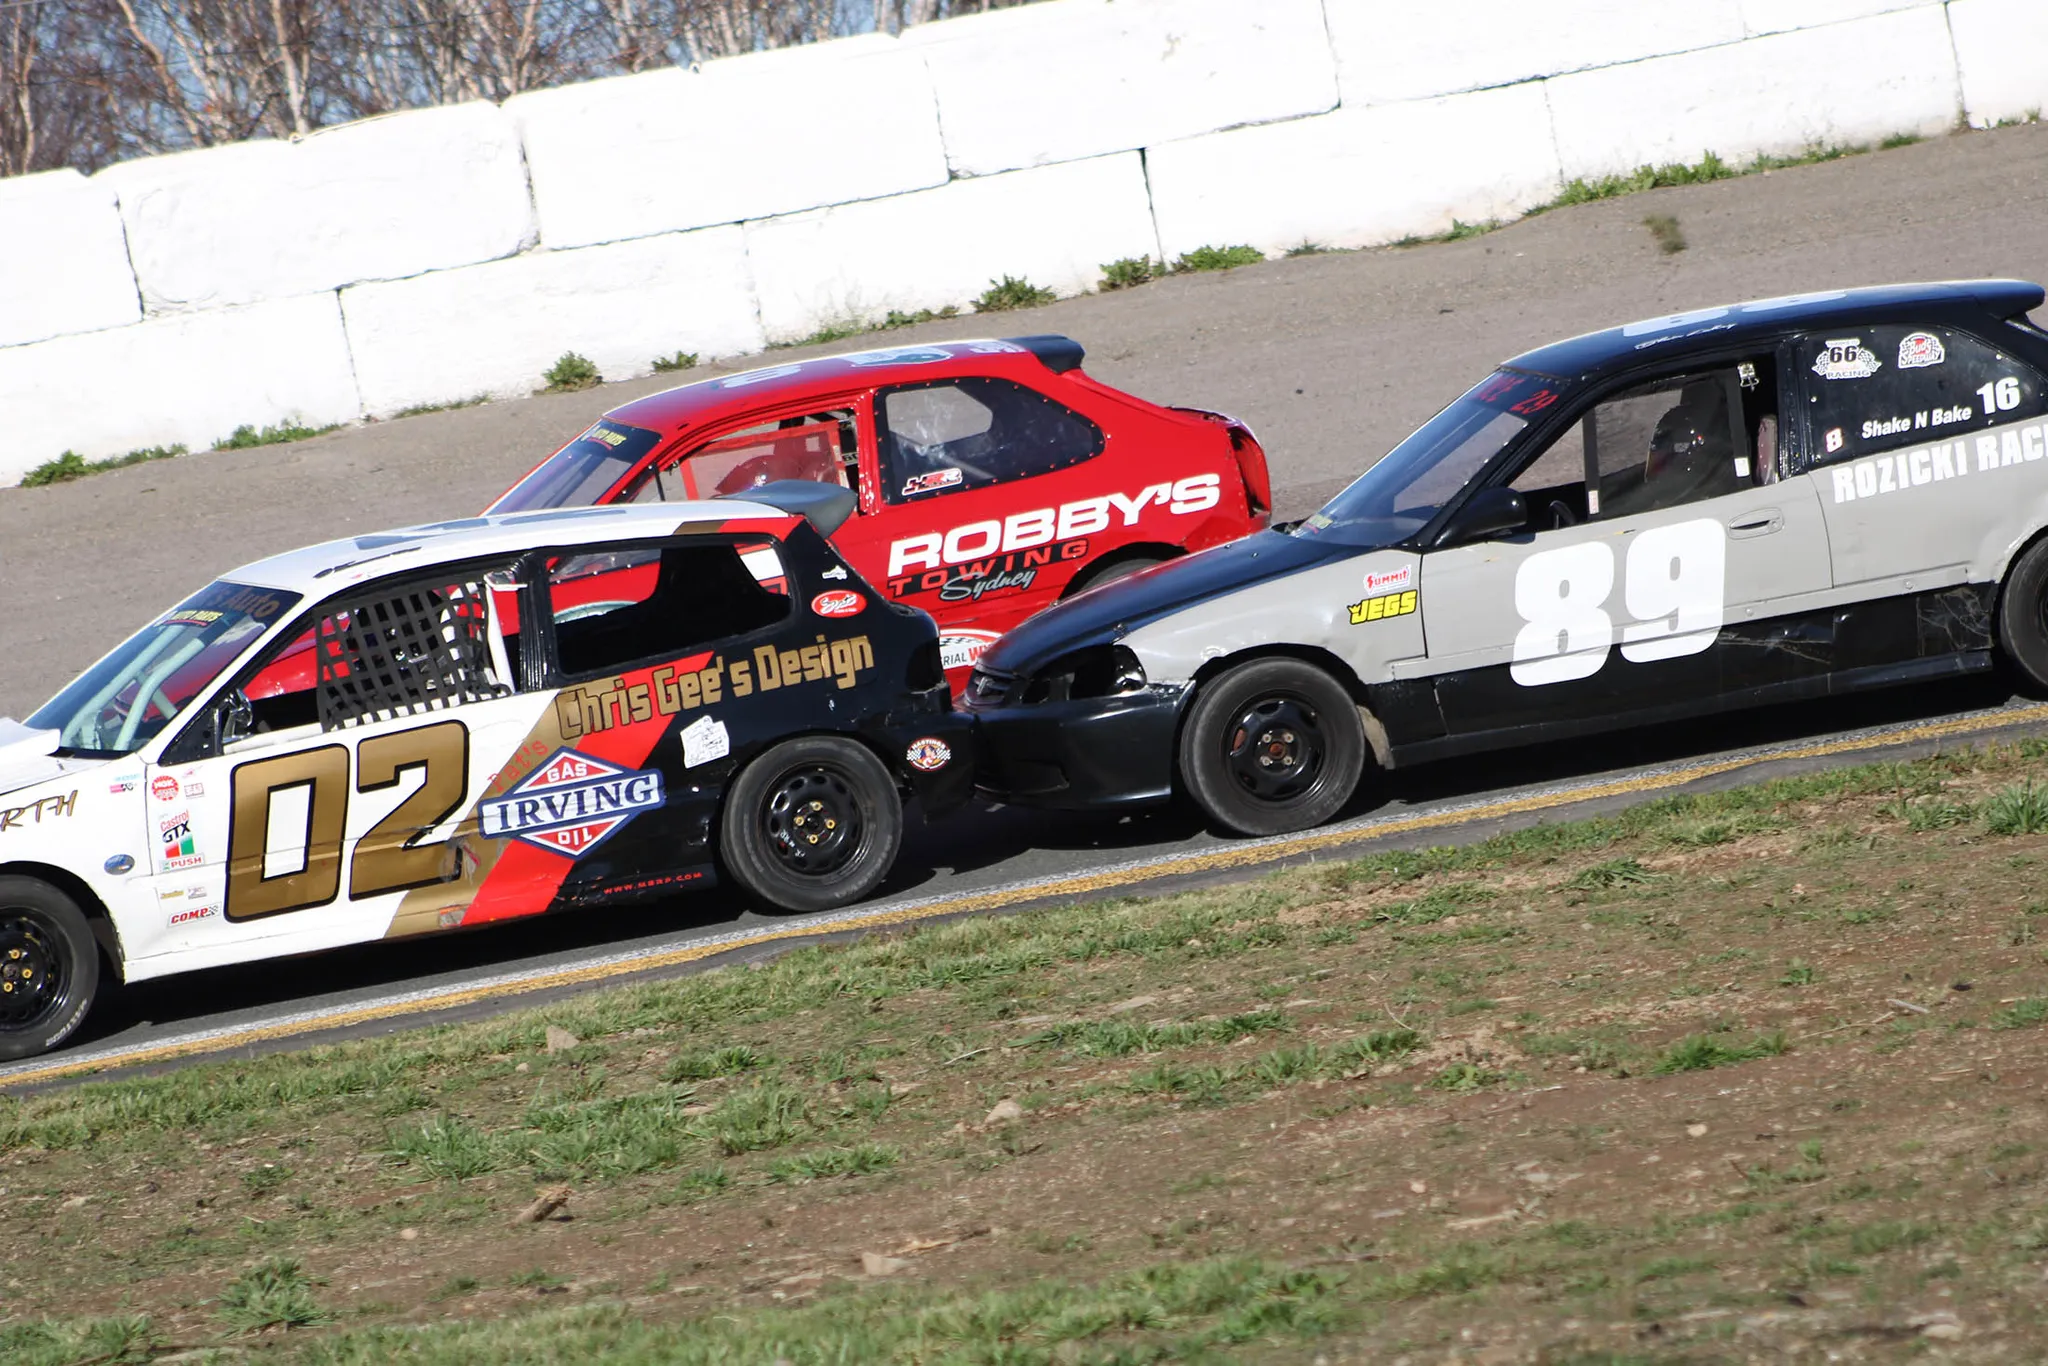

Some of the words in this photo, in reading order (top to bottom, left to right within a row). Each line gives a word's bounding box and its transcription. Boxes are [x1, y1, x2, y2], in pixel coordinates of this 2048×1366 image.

[1829, 345, 1857, 363] 66
[1827, 369, 1870, 379] RACING
[1976, 376, 2021, 415] 16
[1825, 427, 1844, 452] 8
[1861, 416, 1911, 439] Shake
[1915, 411, 1929, 428] N
[1931, 404, 1972, 427] Bake
[1831, 440, 1969, 504] ROZICKI
[886, 473, 1221, 577] ROBBY'S
[887, 539, 1088, 597] TOWING
[940, 568, 1037, 601] Sydney
[1348, 589, 1418, 625] JEGS
[1510, 518, 1726, 687] 89
[556, 678, 652, 740] Chris
[653, 655, 752, 716] Gee's
[753, 634, 875, 690] Design
[546, 761, 588, 783] GAS
[160, 809, 190, 832] Castrol
[496, 776, 654, 830] IRVING
[162, 820, 191, 843] GTX
[223, 719, 470, 924] 02
[558, 827, 593, 845] OIL
[170, 856, 202, 869] PUSH
[170, 907, 209, 924] COMP
